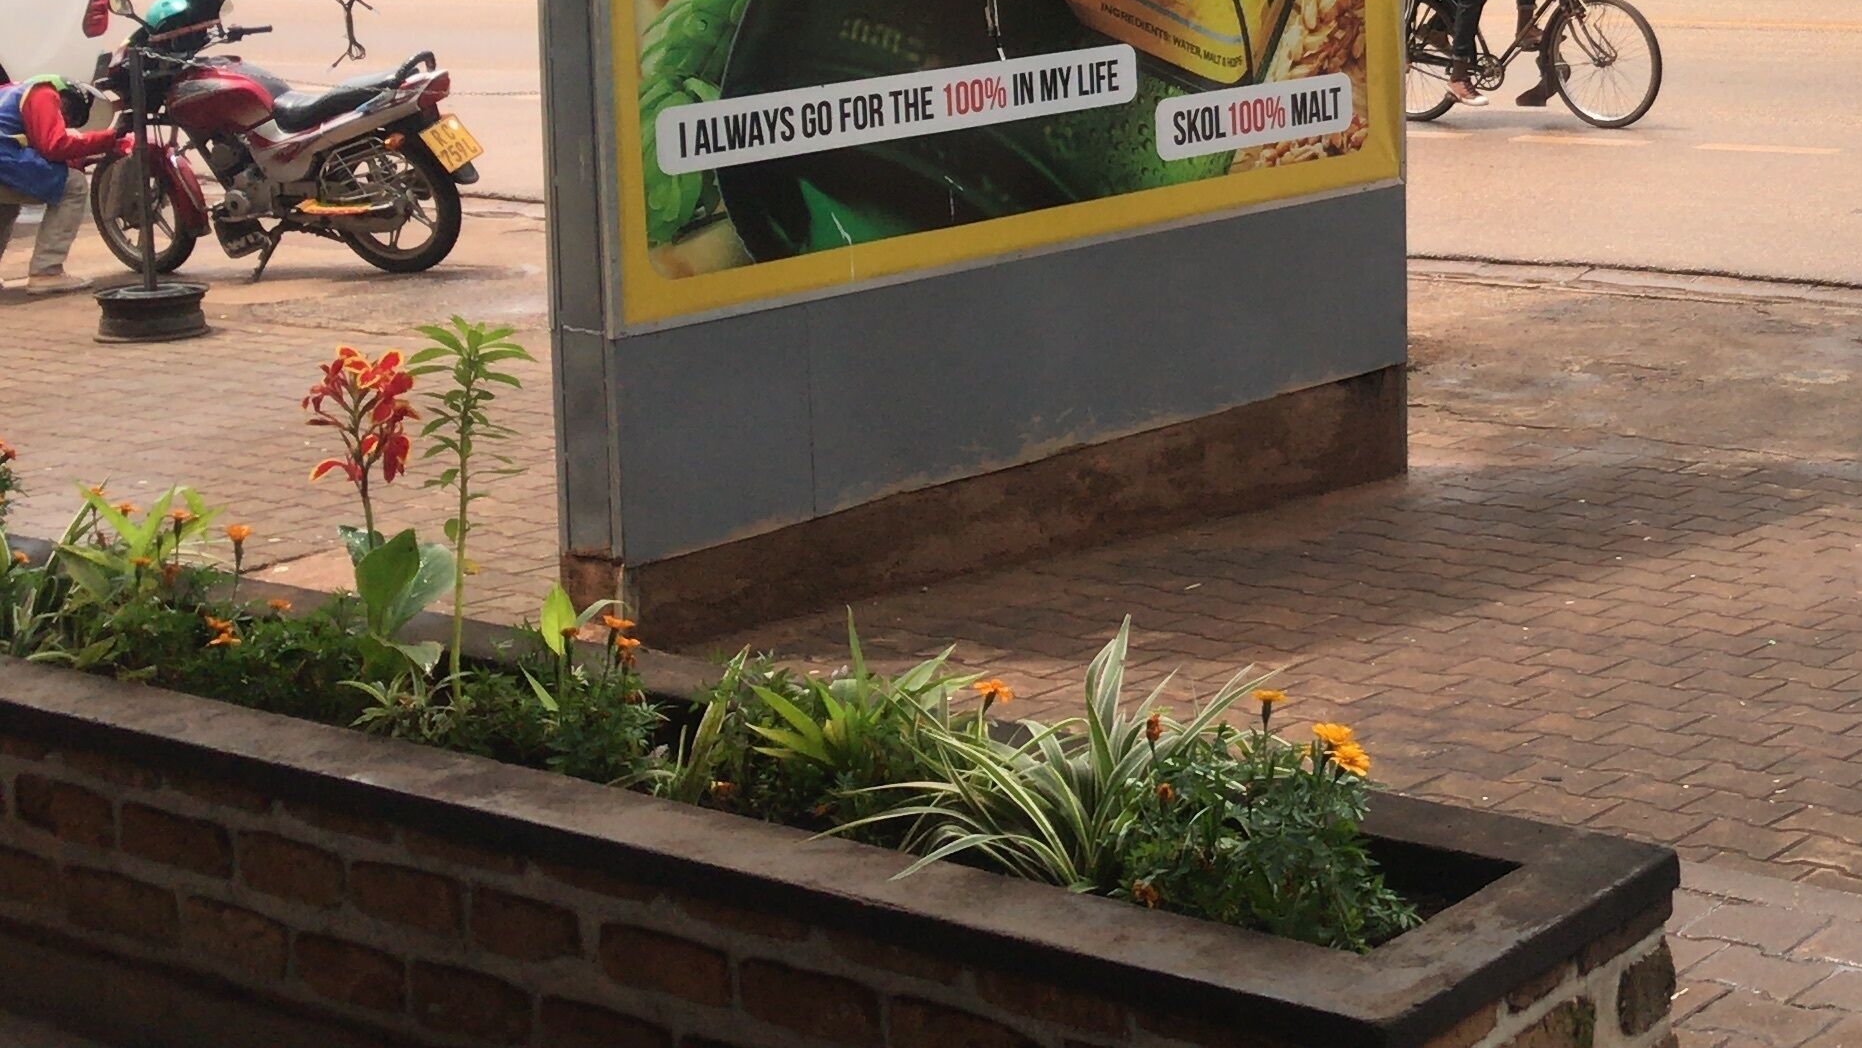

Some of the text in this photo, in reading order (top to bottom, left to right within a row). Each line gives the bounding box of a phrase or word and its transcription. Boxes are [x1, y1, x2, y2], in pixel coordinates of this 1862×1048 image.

[1101, 2, 1171, 42] INGREDIENTS:
[1203, 49, 1222, 65] MALT
[429, 124, 456, 147] RC
[678, 59, 1120, 158] I ALWAYS GO FOR THE 100% IN MY LIFE
[1172, 87, 1342, 146] SKOL 100% MALT
